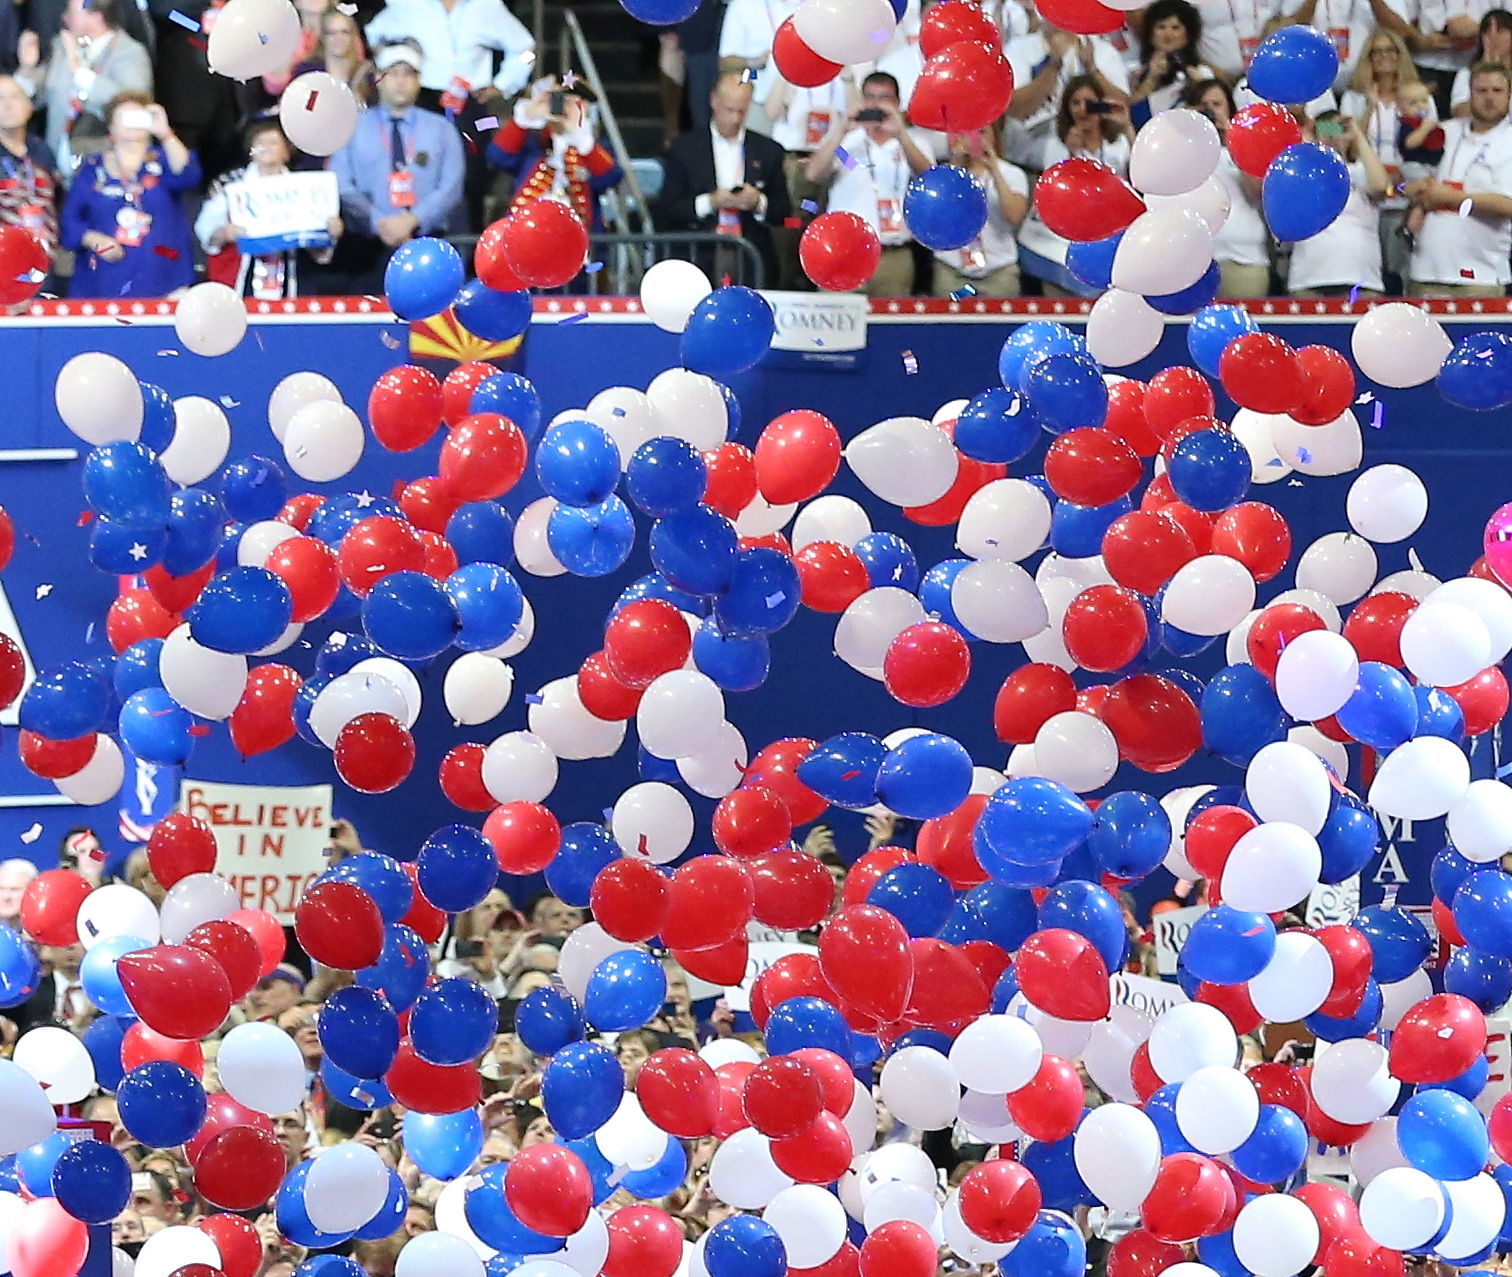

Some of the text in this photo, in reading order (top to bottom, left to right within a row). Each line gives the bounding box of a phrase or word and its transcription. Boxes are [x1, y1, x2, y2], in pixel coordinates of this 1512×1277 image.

[772, 302, 856, 334] OMNEY
[189, 788, 324, 829] BELIEVE
[238, 833, 285, 857] IN
